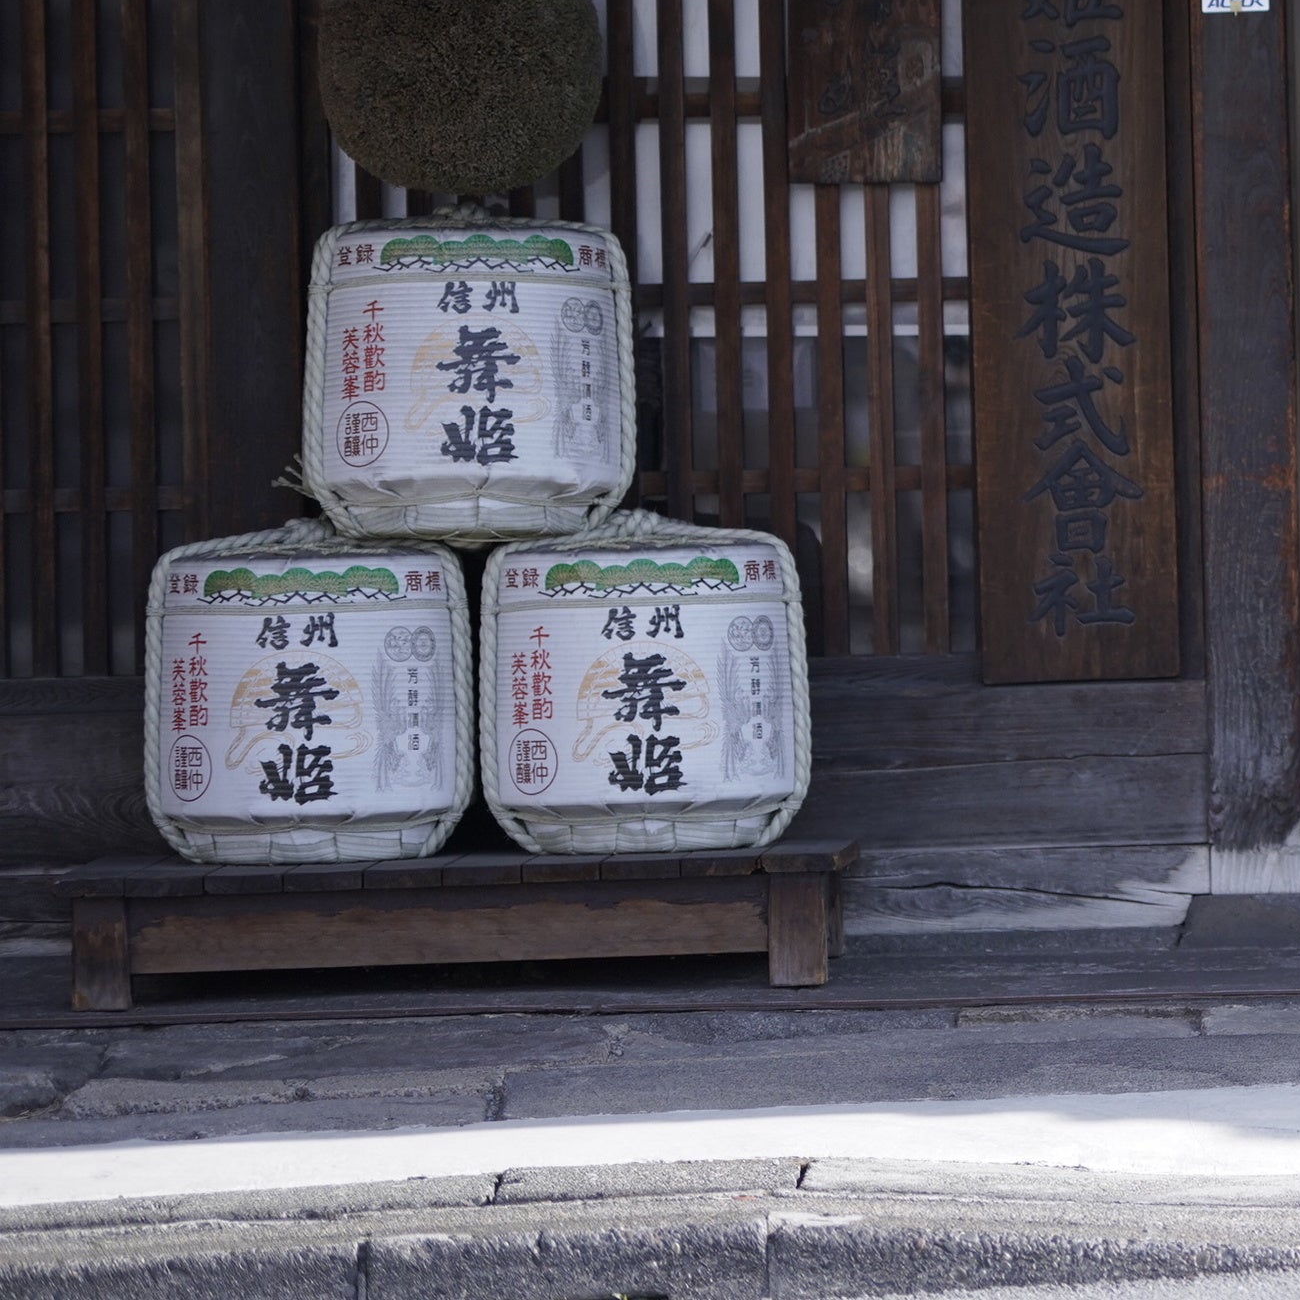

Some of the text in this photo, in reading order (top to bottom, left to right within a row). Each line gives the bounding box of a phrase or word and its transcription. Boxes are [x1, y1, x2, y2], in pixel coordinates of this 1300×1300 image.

[336, 243, 608, 271] 登録 商標
[436, 280, 520, 316] 信州
[435, 325, 521, 466] 舞姫
[361, 411, 379, 456] 西仲
[166, 569, 442, 596] 登録 商標
[504, 558, 779, 591] 登録 商標
[254, 610, 340, 651] 信州
[601, 604, 685, 641] 信州
[253, 660, 341, 806] 舞姫
[601, 651, 687, 796] 舞姫
[188, 746, 204, 791] 西仲
[531, 738, 549, 788] 西仲
